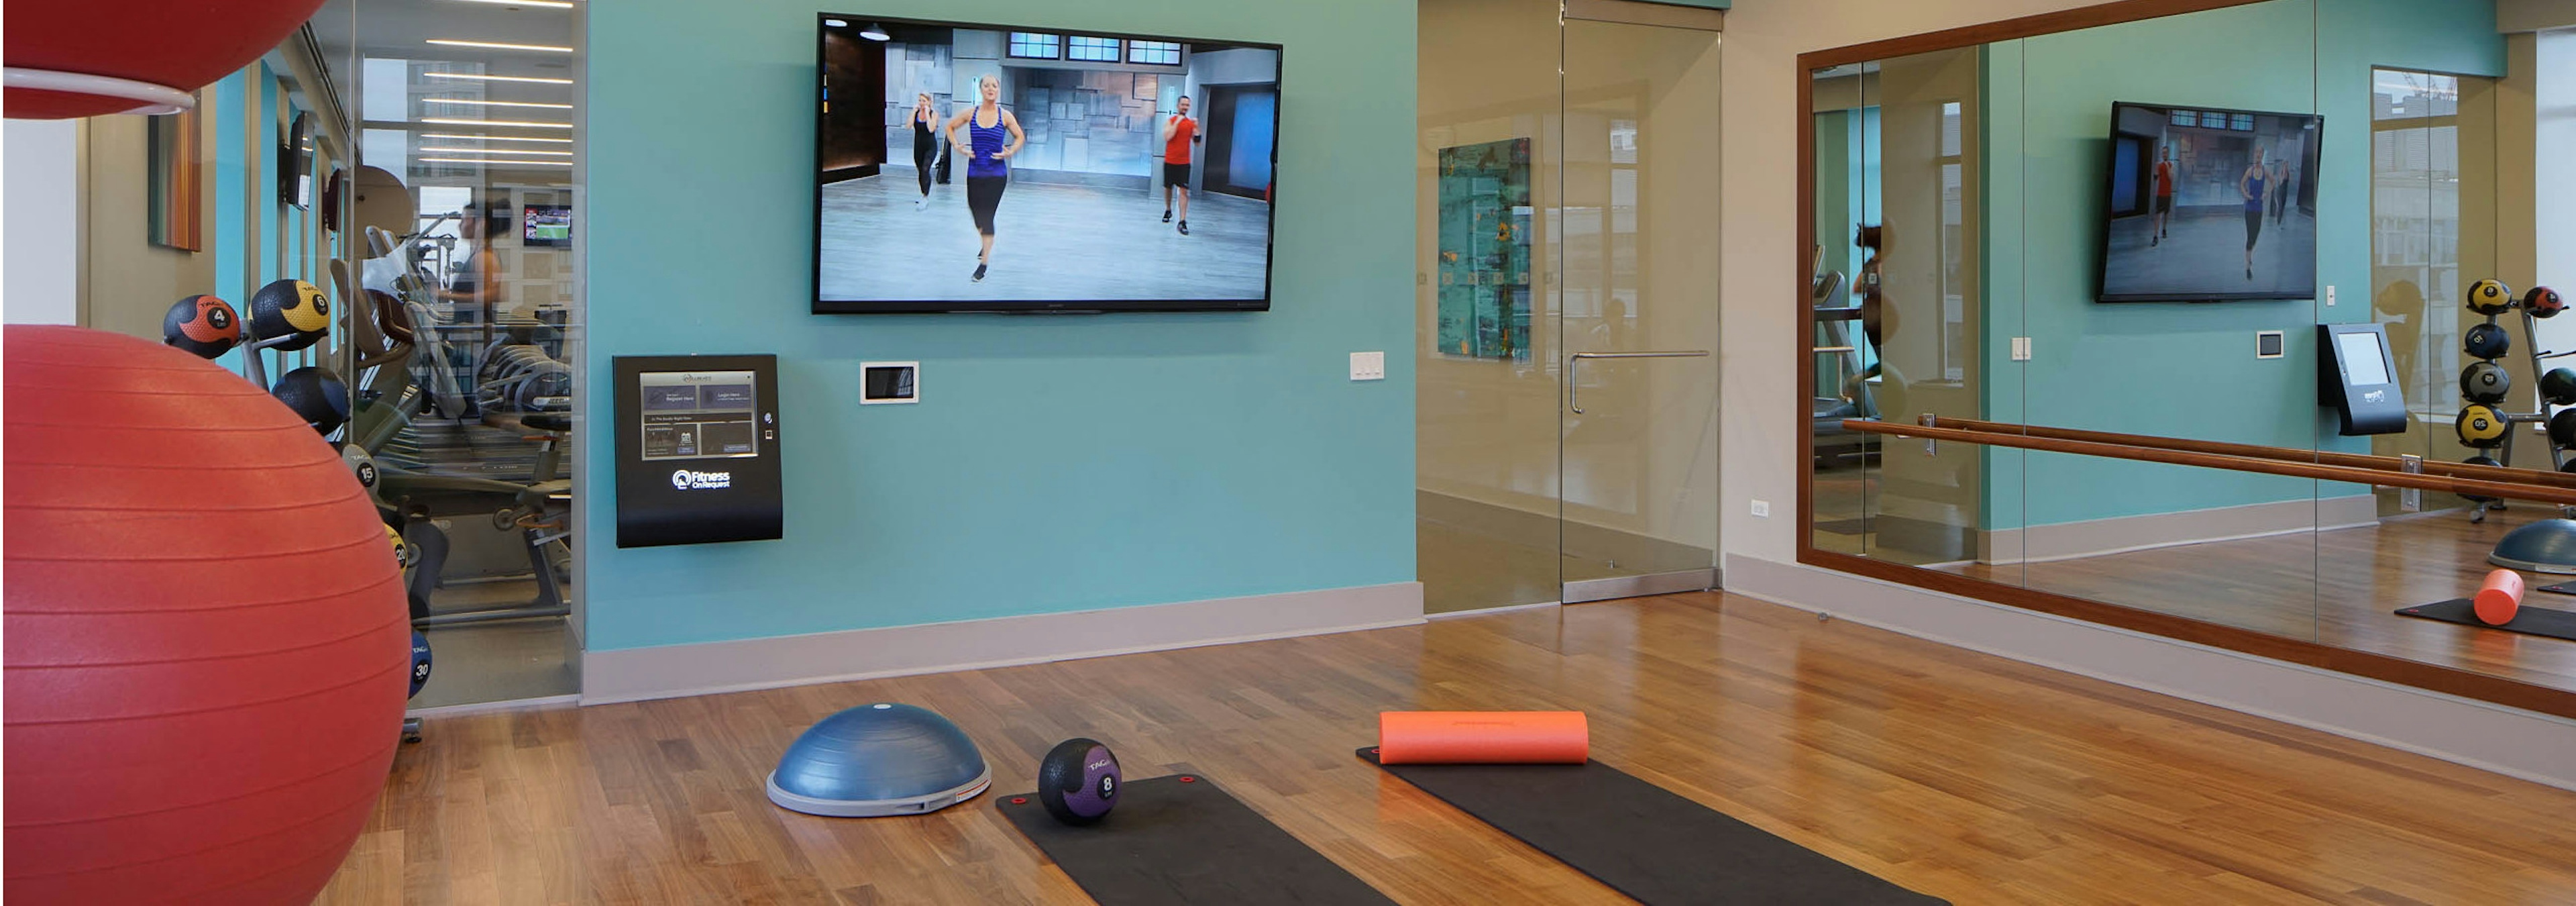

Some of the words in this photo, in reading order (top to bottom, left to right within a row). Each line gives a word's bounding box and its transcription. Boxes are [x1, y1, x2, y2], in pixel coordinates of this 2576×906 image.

[317, 296, 325, 306] 6
[214, 309, 225, 321] 4
[361, 467, 373, 479] 15
[692, 471, 730, 481] Fitness
[396, 549, 405, 560] 20
[416, 664, 428, 676] 30
[1104, 777, 1112, 791] 8
